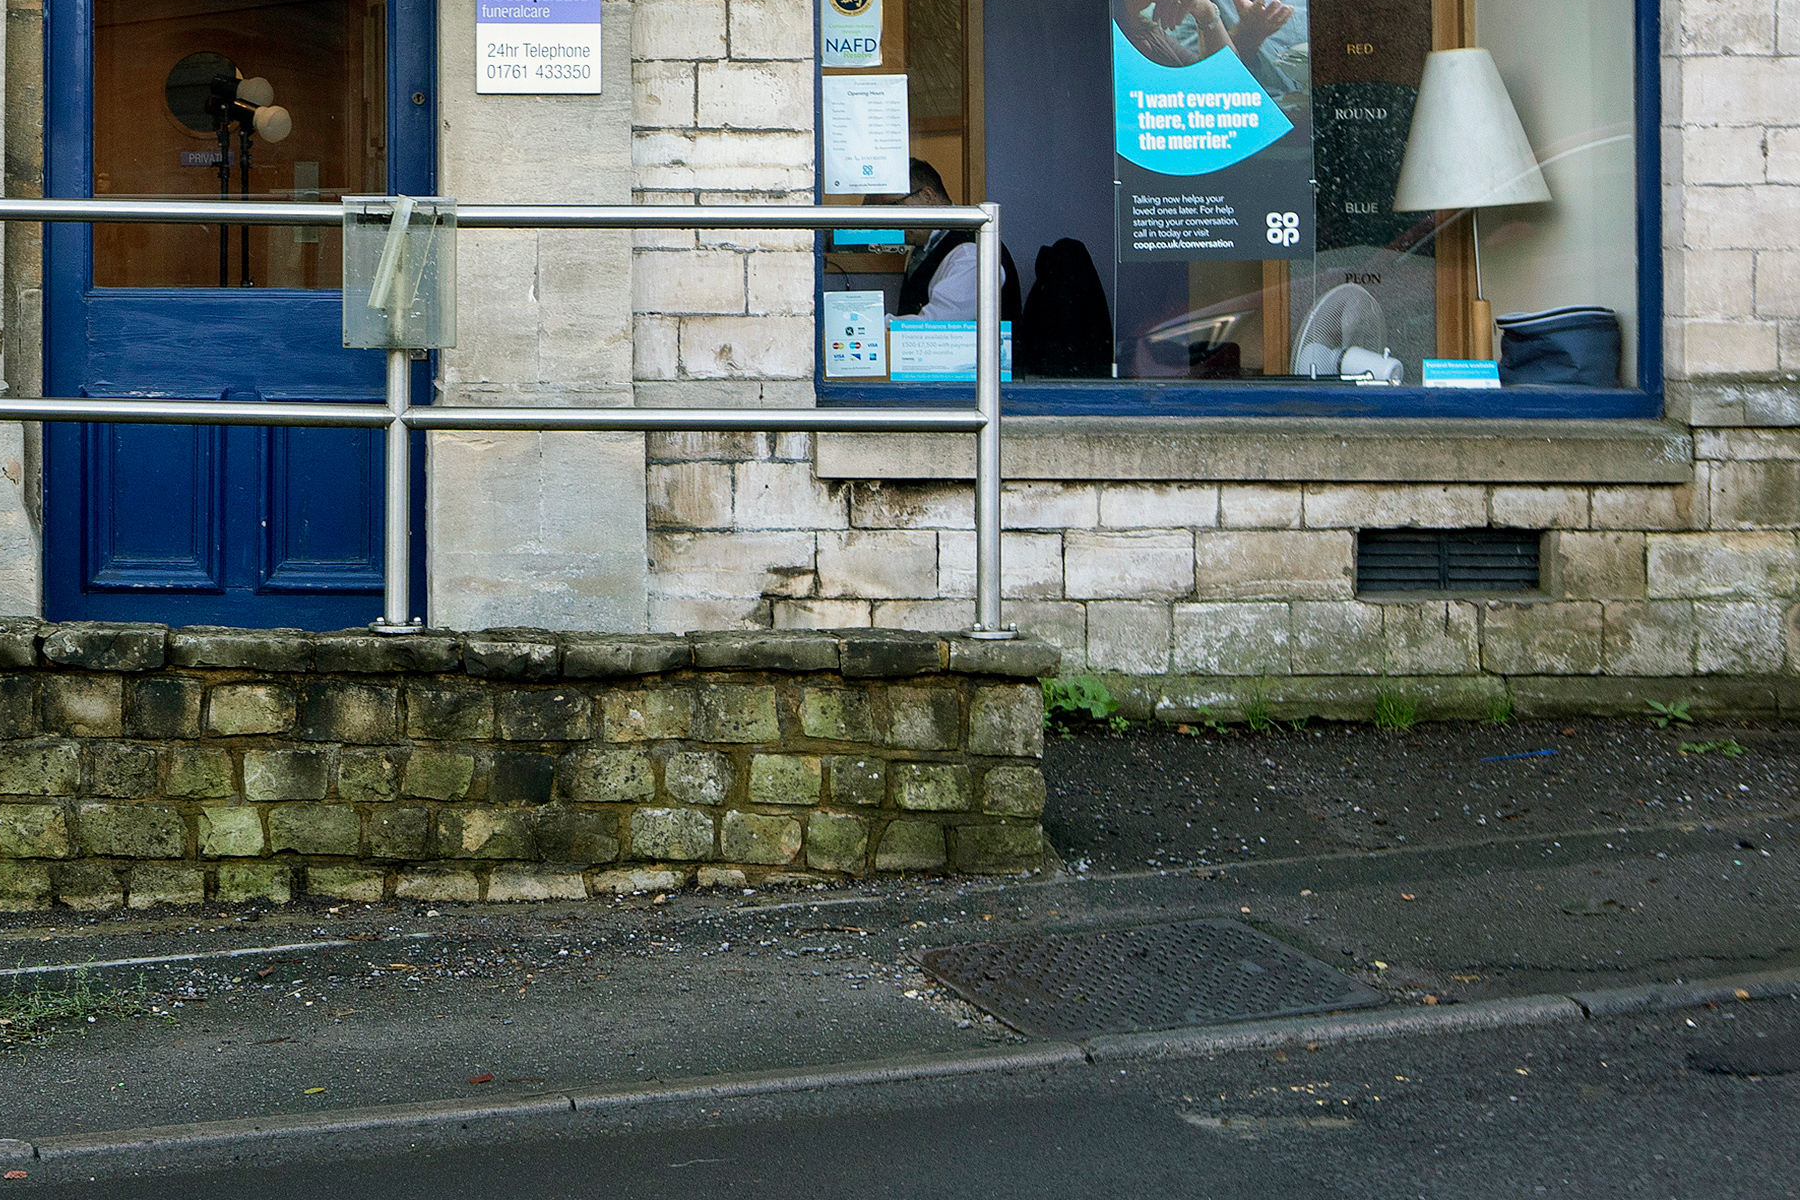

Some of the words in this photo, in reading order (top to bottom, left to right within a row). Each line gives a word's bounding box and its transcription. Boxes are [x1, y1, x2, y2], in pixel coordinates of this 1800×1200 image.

[482, 4, 550, 18] funeralcare
[826, 38, 877, 52] NAFD
[1347, 44, 1374, 56] RED
[487, 43, 519, 58] 24hr
[522, 43, 590, 60] Telephone
[844, 51, 873, 59] Resolve
[486, 64, 528, 79] 01761
[536, 64, 591, 79] 433350
[1146, 92, 1184, 108] want
[1187, 92, 1261, 110] everyone
[1334, 108, 1388, 120] ROUND
[1138, 112, 1186, 130] there,
[1188, 111, 1215, 128] the
[1217, 113, 1259, 128] more
[1139, 133, 1166, 150] the
[1132, 195, 1161, 206] Talking
[1163, 196, 1180, 204] now
[1182, 194, 1204, 205] helps
[1206, 196, 1224, 205] your
[1133, 206, 1155, 216] loved
[1179, 206, 1198, 215] later.
[1200, 206, 1214, 215] For
[1215, 206, 1235, 216] help
[1345, 202, 1379, 214] BLUE
[1133, 218, 1164, 228] starting
[1166, 219, 1184, 228] your
[1185, 217, 1239, 226] conversation,
[1133, 229, 1148, 238] call
[1150, 229, 1157, 237] in
[1158, 228, 1181, 239] today
[1193, 228, 1210, 237] visit
[1133, 239, 1234, 251] coop.co.uk/conversation
[1344, 272, 1381, 284] PEON
